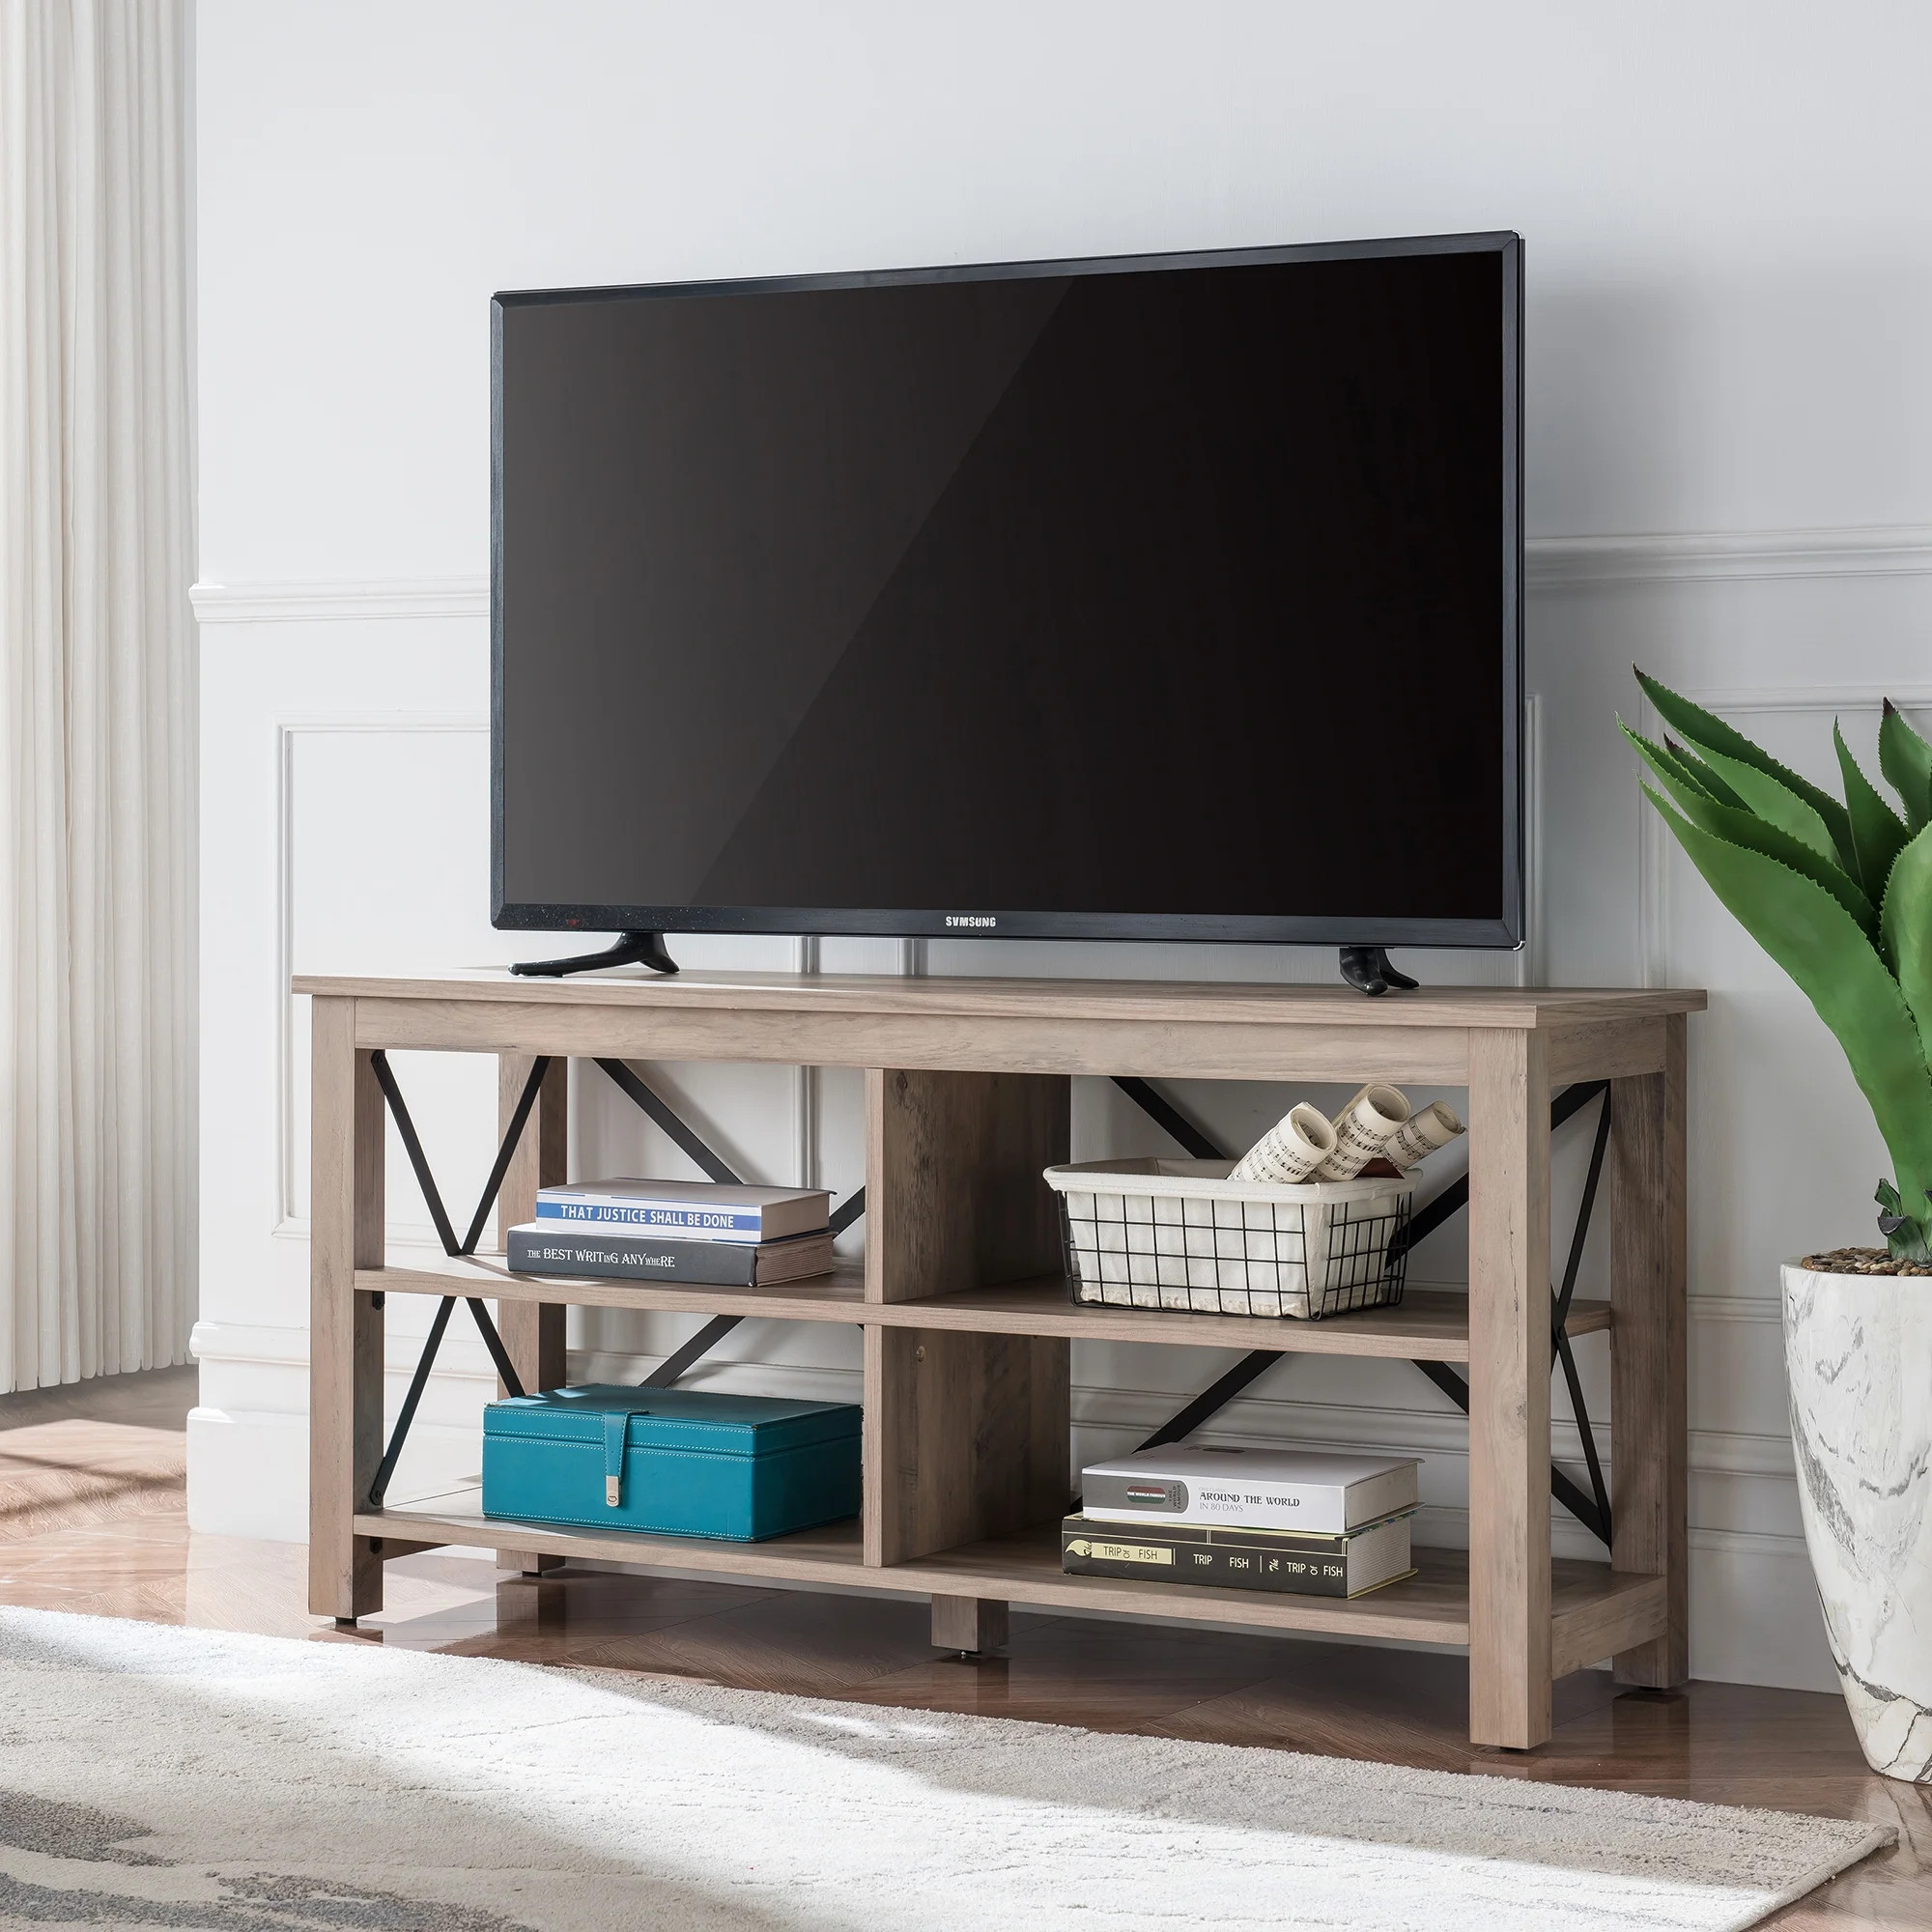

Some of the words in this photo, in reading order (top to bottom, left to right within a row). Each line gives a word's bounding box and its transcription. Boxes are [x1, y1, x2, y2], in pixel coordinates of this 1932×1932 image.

[560, 1205, 593, 1219] THAT
[596, 1207, 646, 1223] JUSTICE
[650, 1210, 684, 1225] SHALL
[687, 1213, 700, 1226] BE
[703, 1214, 734, 1228] DONE
[527, 1249, 541, 1259] THE
[543, 1247, 573, 1261] BEST
[1199, 1492, 1240, 1503] AROUND
[1243, 1494, 1263, 1505] THE
[1265, 1496, 1300, 1508] WORLD
[1210, 1503, 1221, 1512] 80
[1222, 1503, 1244, 1513] DAYS
[1103, 1546, 1122, 1557] TRIP
[1138, 1548, 1158, 1560] FISH
[1193, 1553, 1212, 1565] TRIP
[1229, 1556, 1249, 1569] FISH
[1268, 1558, 1279, 1572] The
[1287, 1561, 1306, 1574] TRIP
[1323, 1565, 1344, 1577] FISH
